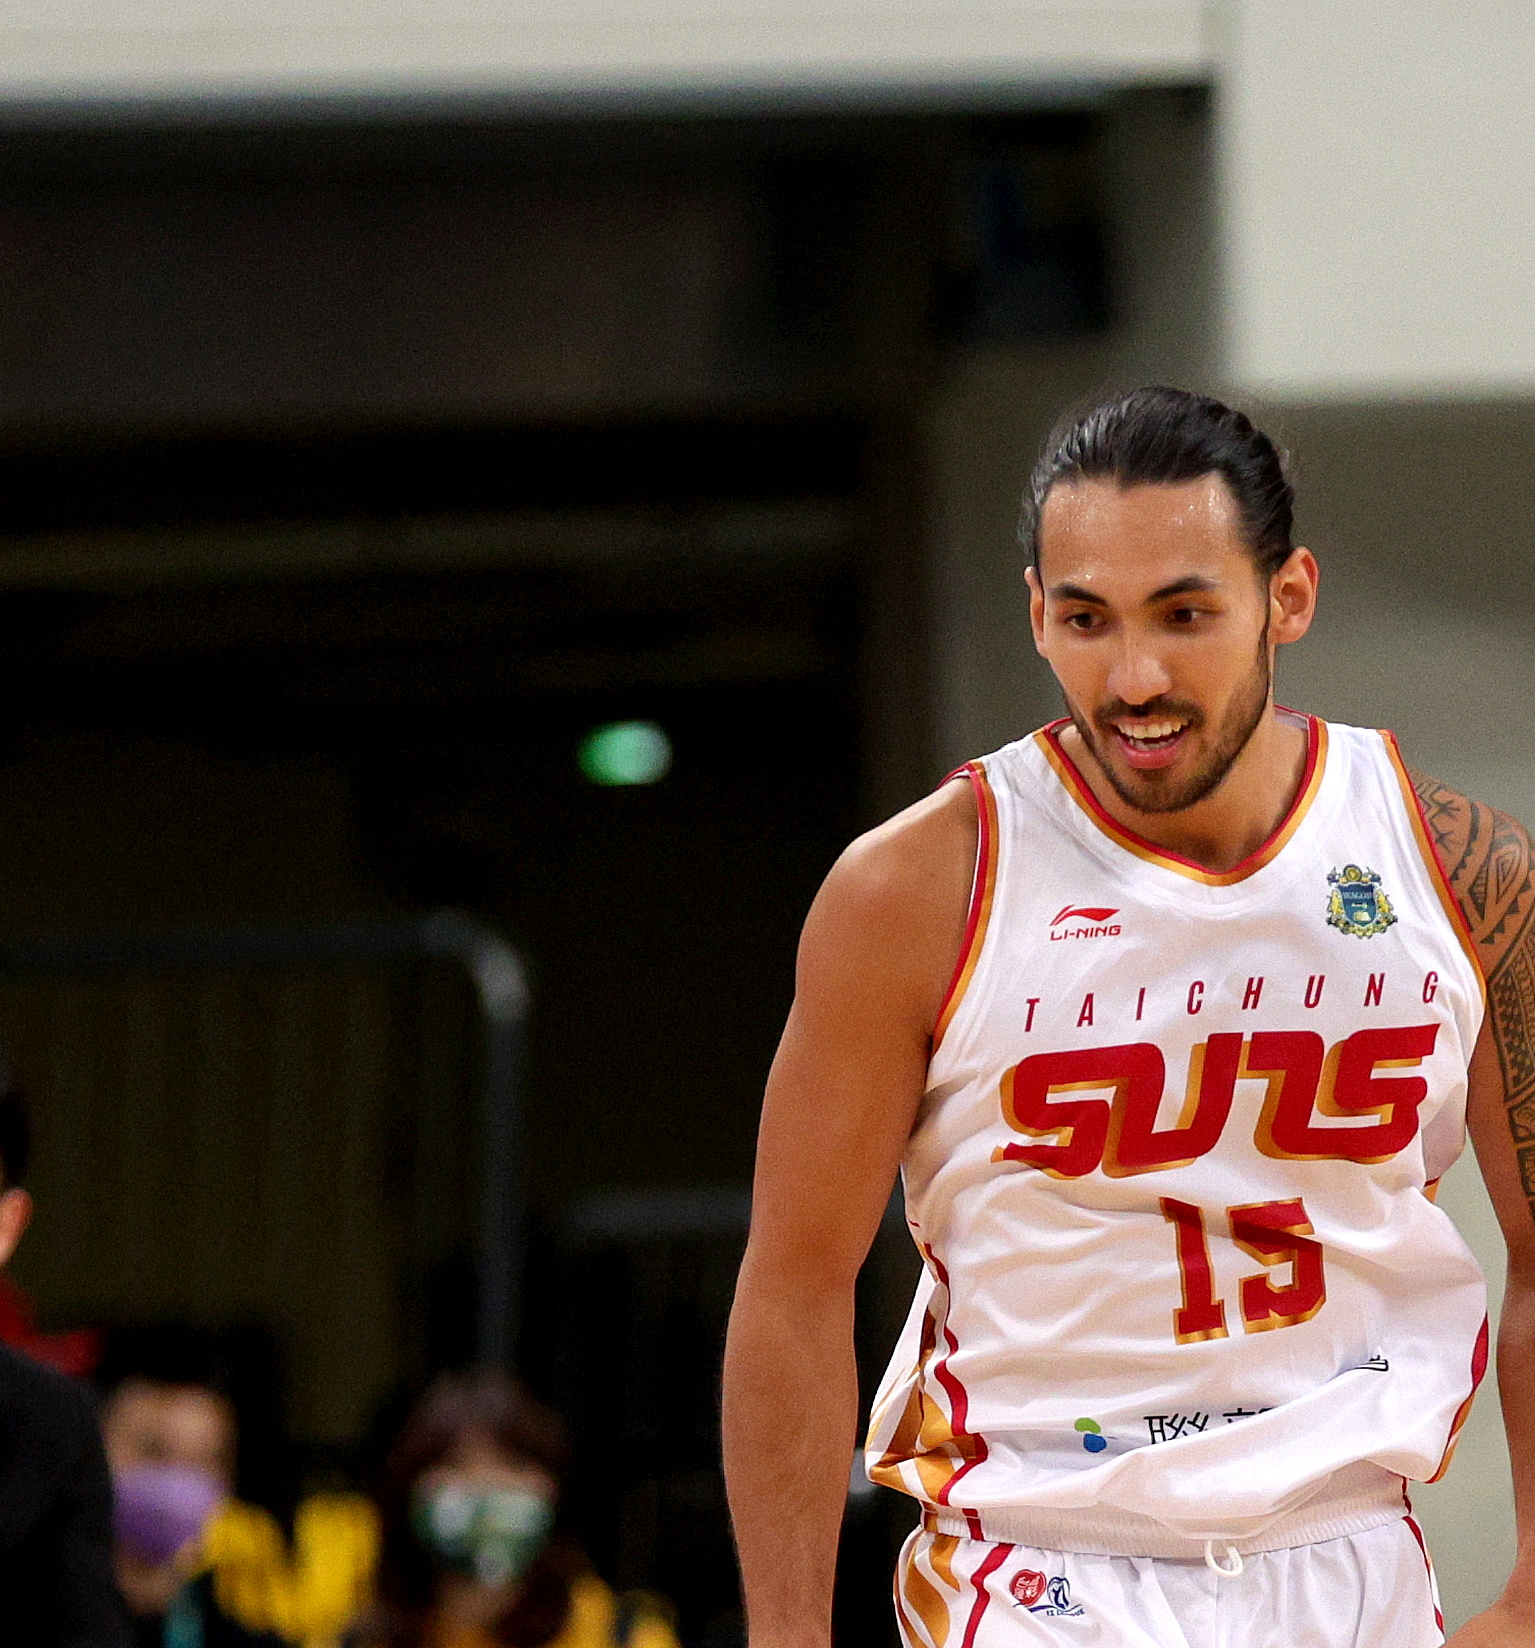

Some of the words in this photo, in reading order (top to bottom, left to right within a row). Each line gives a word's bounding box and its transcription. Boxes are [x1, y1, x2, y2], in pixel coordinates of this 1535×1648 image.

[1050, 925, 1121, 941] LI-NING
[1024, 969, 1440, 1033] TAICHUNG
[1158, 1196, 1327, 1346] 15
